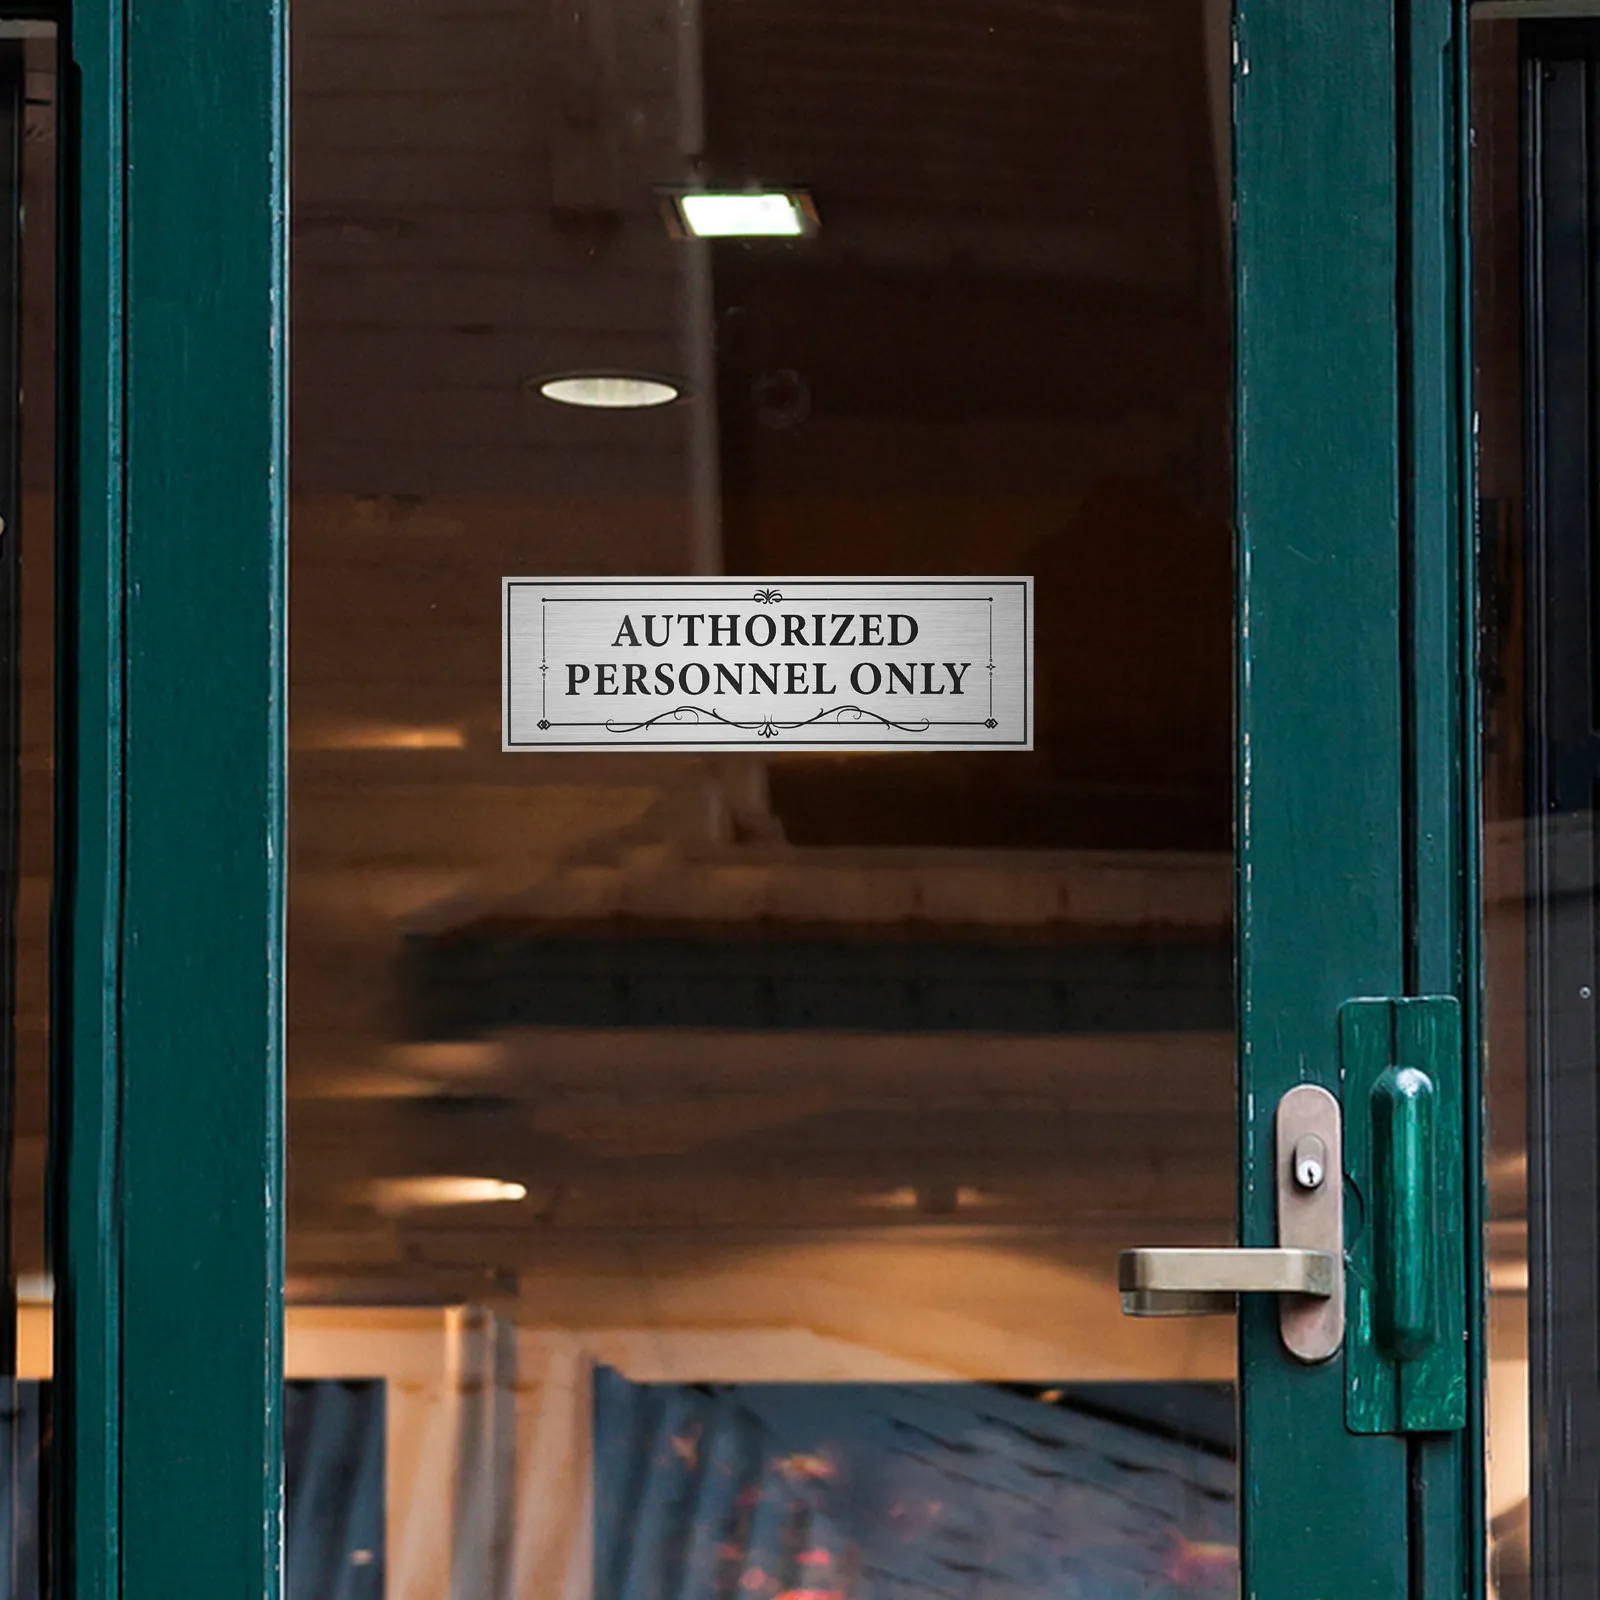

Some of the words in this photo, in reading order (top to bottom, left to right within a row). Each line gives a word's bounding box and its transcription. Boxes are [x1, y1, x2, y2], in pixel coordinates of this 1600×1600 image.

[610, 613, 919, 647] AUTHORIZED
[565, 662, 837, 696] PERSONNEL
[850, 662, 972, 696] ONLY
